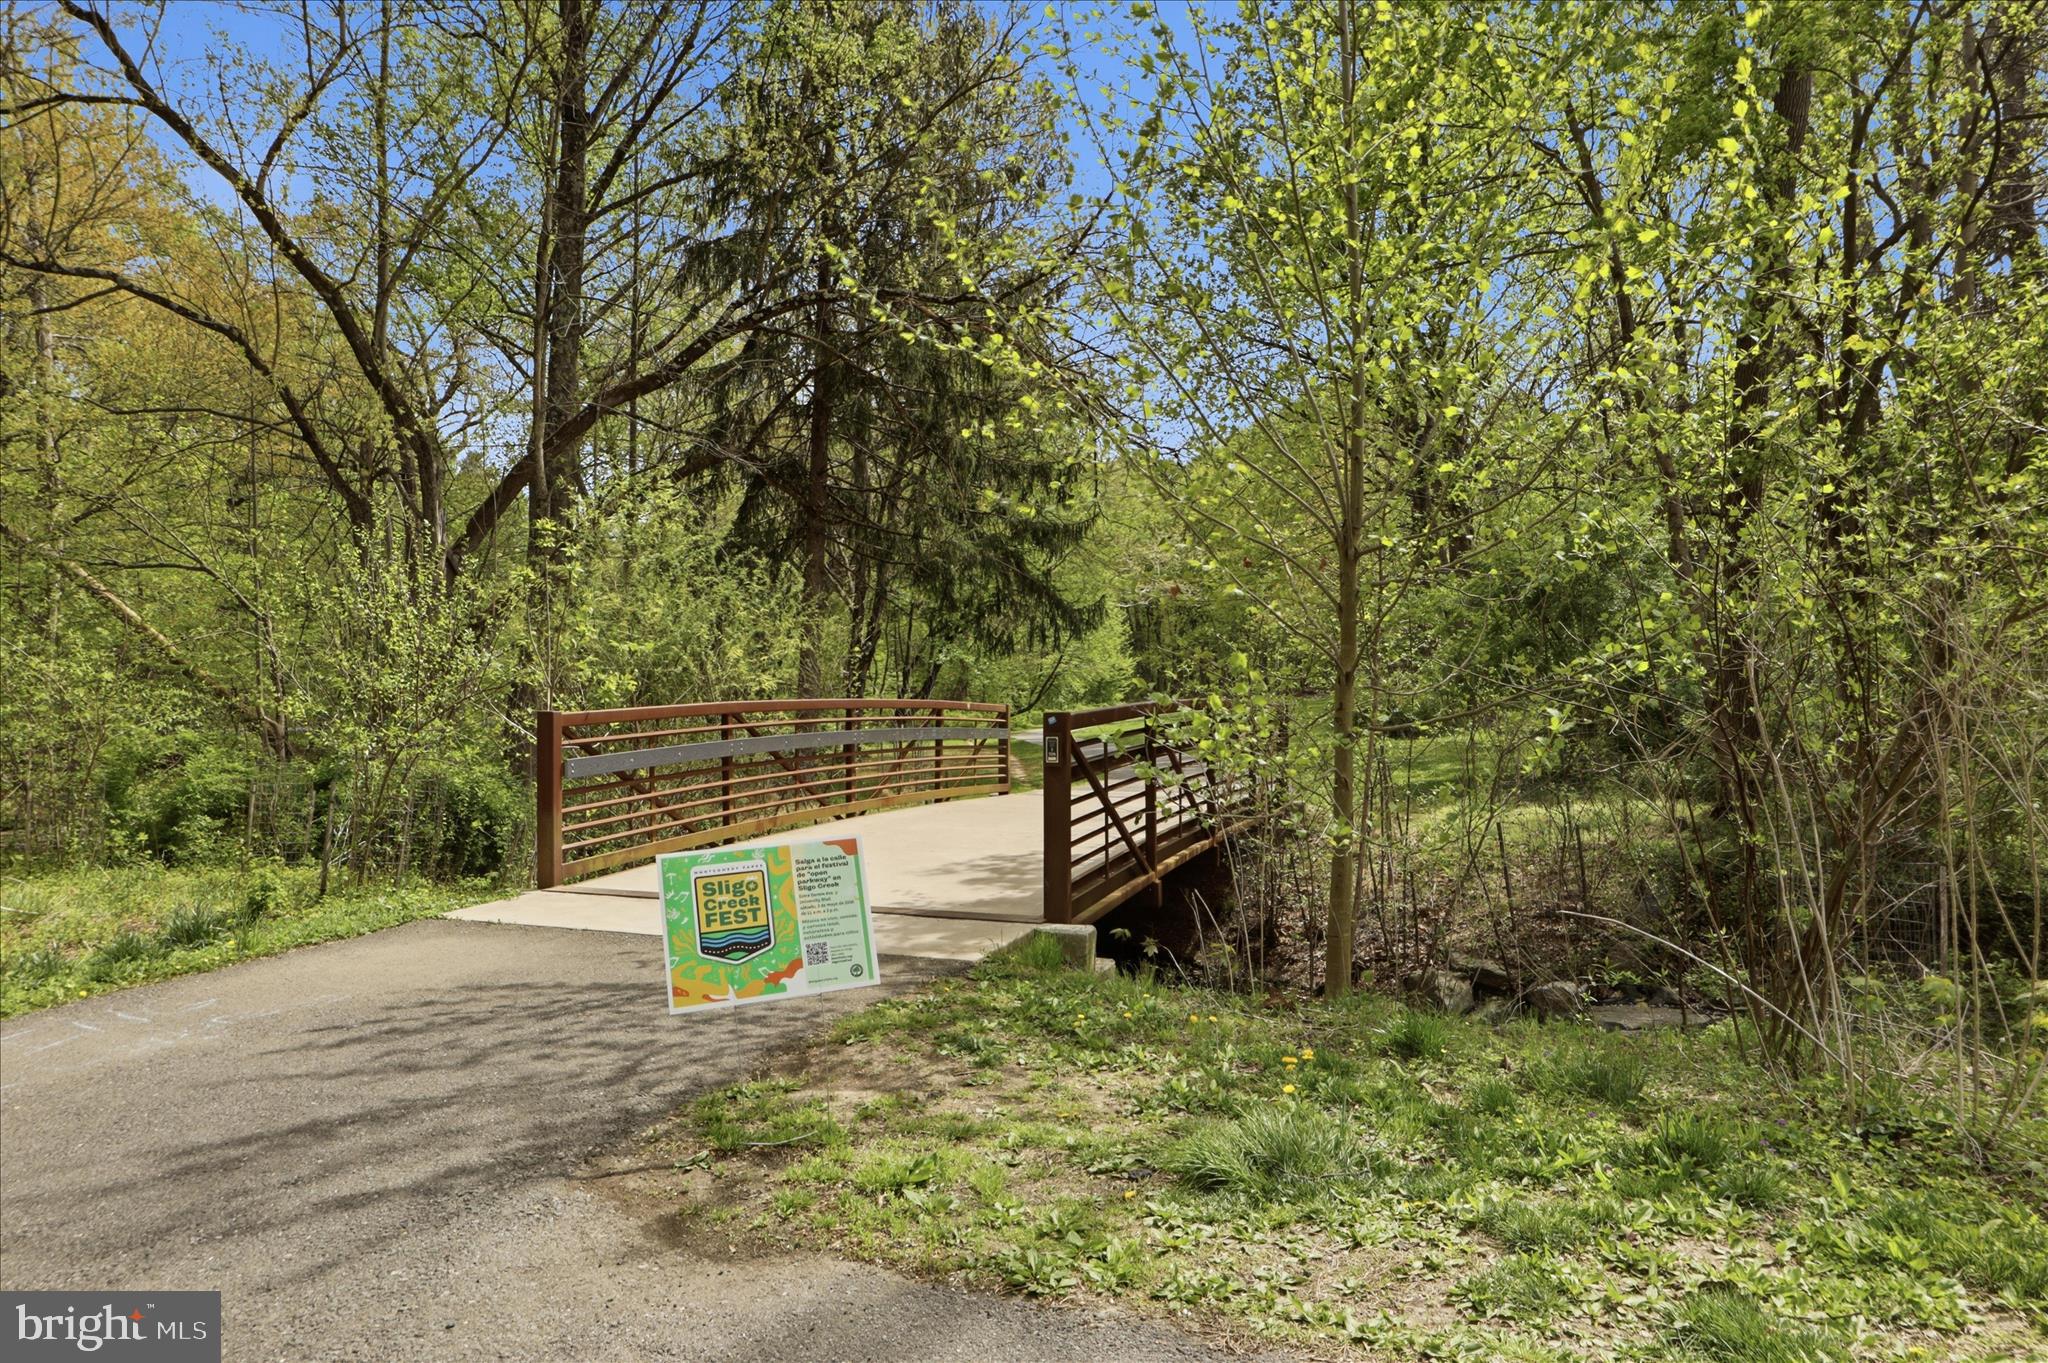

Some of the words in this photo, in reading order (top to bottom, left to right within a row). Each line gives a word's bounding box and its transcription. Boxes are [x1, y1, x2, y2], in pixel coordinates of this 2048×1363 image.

[702, 880, 759, 897] Sligo
[704, 895, 759, 911] Creek
[705, 908, 761, 927] FEST
